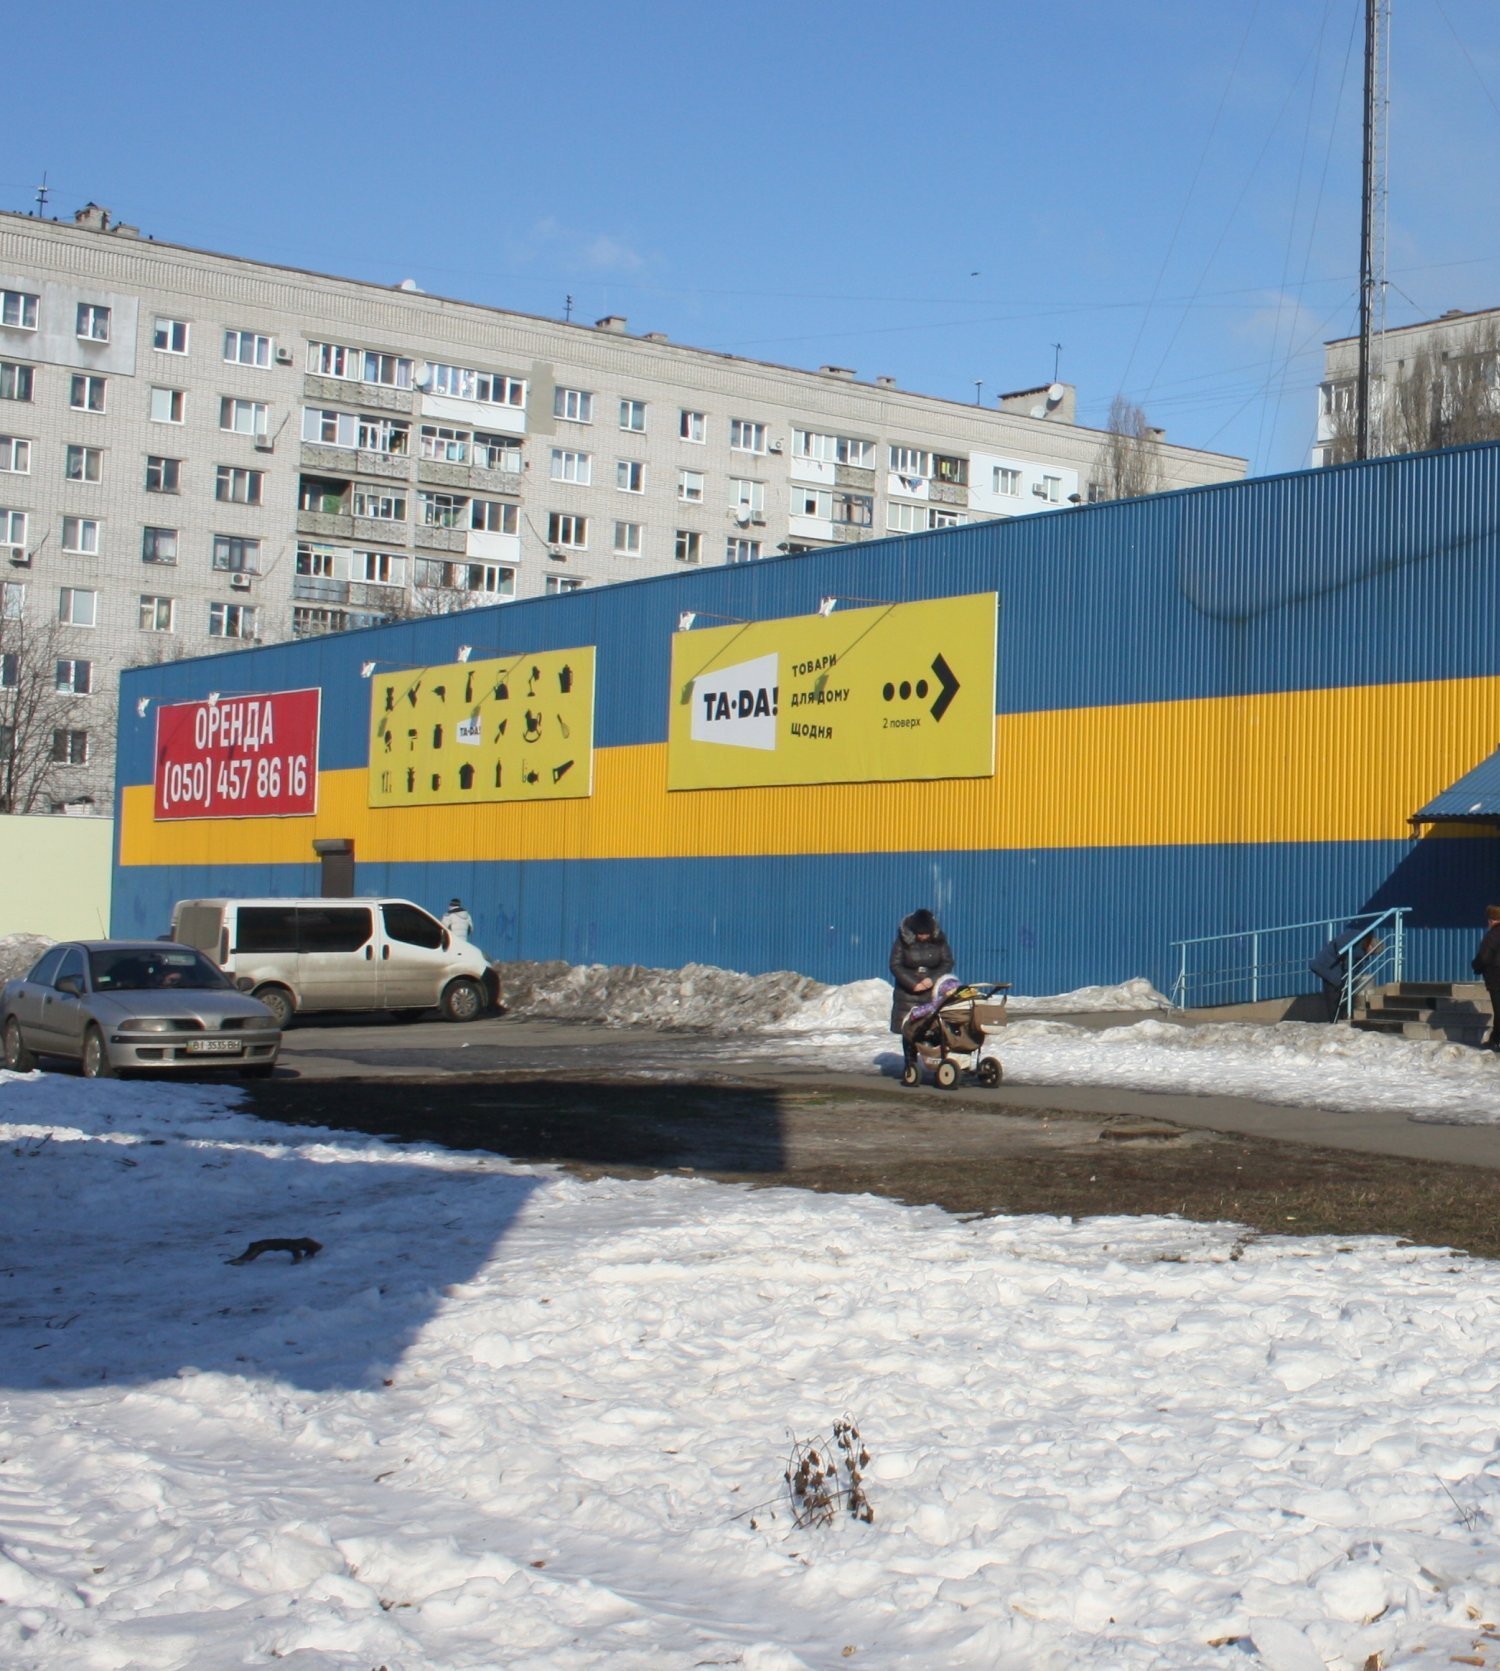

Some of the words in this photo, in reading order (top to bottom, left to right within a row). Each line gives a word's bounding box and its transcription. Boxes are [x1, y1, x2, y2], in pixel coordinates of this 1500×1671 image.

[792, 653, 837, 678] ТОВАРИ
[791, 692, 815, 708] ДЛЯ
[817, 688, 850, 705] ДОМУ
[195, 701, 273, 753] ОРЕНДА
[791, 722, 833, 740] ЩОДНЯ
[882, 717, 889, 729] 2
[890, 718, 921, 730] поверх
[163, 757, 212, 810] (050)
[217, 759, 252, 800] 457
[257, 756, 281, 798] 86
[288, 755, 307, 796] 16
